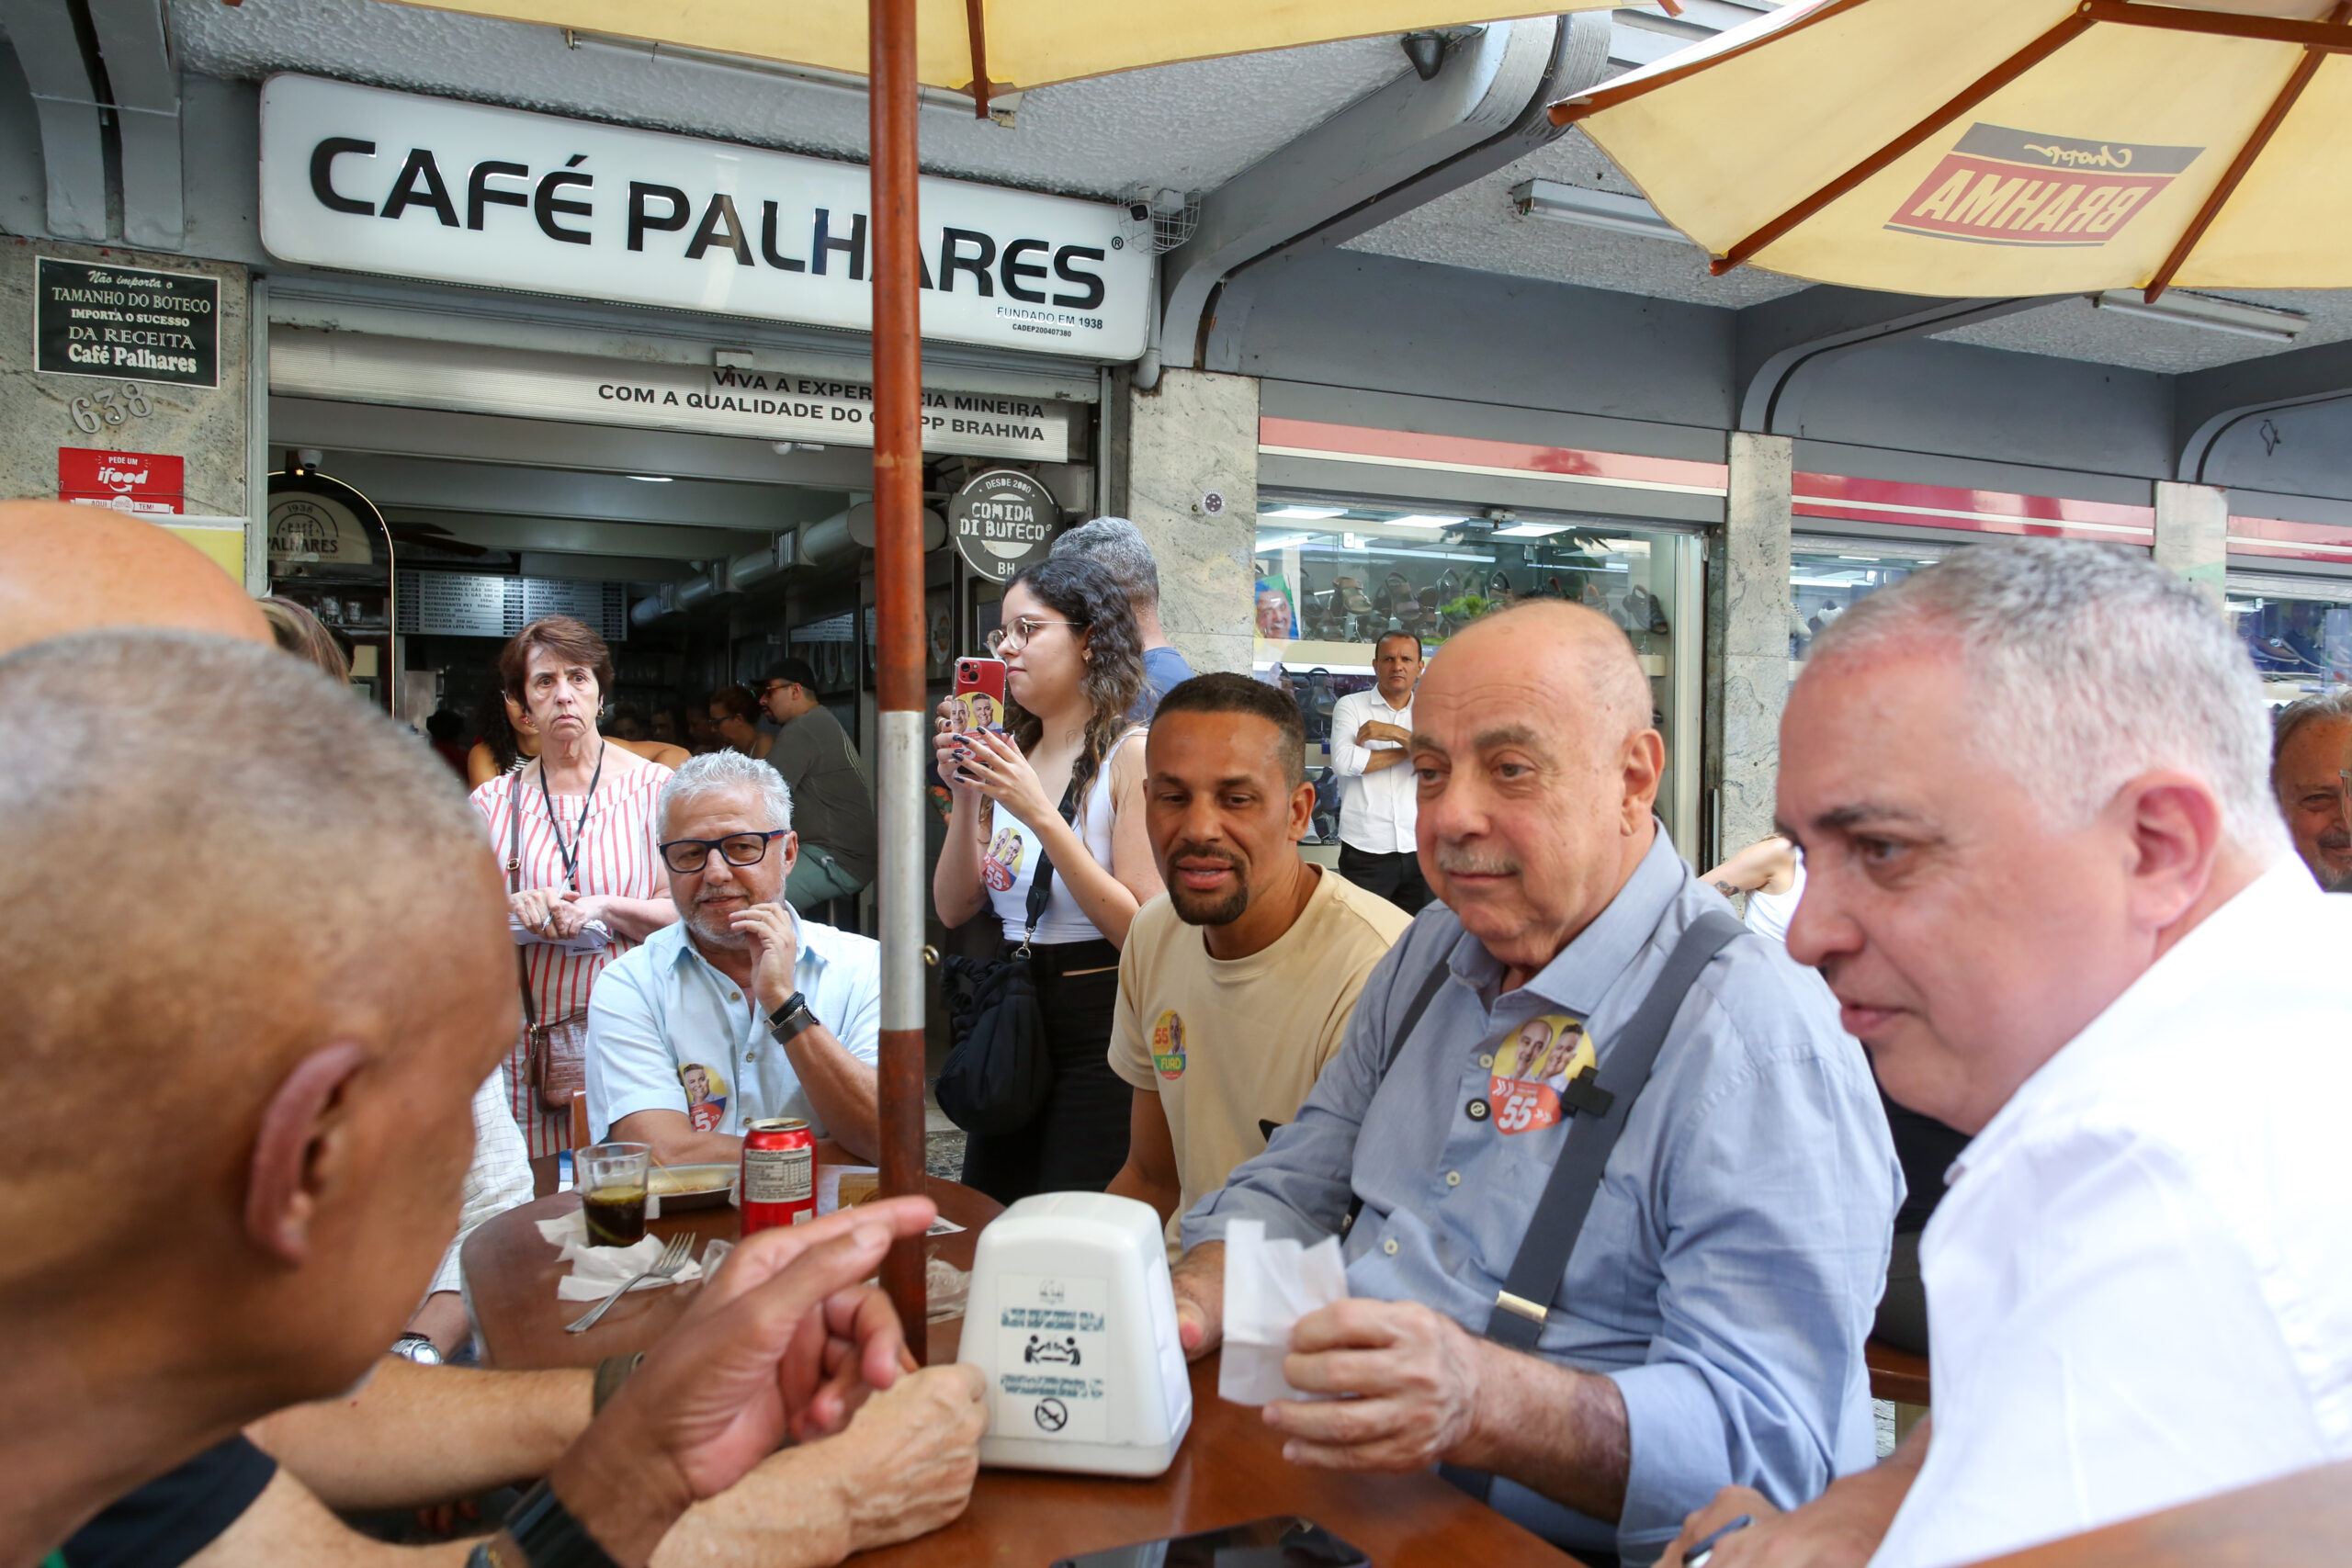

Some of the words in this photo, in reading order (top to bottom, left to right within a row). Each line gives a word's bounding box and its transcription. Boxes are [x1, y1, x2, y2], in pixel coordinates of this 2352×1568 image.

[310, 136, 594, 246] CAFÉ
[628, 180, 1105, 310] PALHRES
[88, 270, 112, 284] Não
[116, 275, 162, 288] importa
[166, 281, 174, 289] o
[51, 287, 124, 306] TAMANHO
[128, 292, 150, 308] DO
[153, 295, 211, 314] BOTECO
[71, 308, 123, 321] IMPORTA
[125, 312, 134, 322] O
[136, 314, 190, 328] SUCESSO
[997, 306, 1055, 322] FUNDADO
[1058, 314, 1075, 325] EM
[1079, 317, 1103, 330] 1938
[68, 326, 98, 342] DA
[104, 328, 196, 351] RECEITA
[1012, 323, 1072, 337] CADEP200407380
[68, 344, 110, 365] Café
[114, 346, 198, 374] Palhares
[713, 370, 769, 391] VIVA
[775, 378, 791, 392] A
[955, 396, 1045, 419] MINEIRA
[71, 380, 154, 434] 638
[598, 384, 655, 404] COM
[663, 390, 679, 406] A
[686, 392, 824, 420] QUALIDADE
[831, 406, 863, 423] DO
[952, 419, 1045, 441] BRAHMA
[108, 456, 126, 464] PEDE
[127, 457, 138, 466] UM
[985, 478, 1012, 491] DESDE
[1012, 479, 1032, 493] 2000
[139, 502, 154, 511] TEM!
[971, 502, 1035, 523] COMIDA
[959, 518, 980, 536] DI
[997, 561, 1015, 576] BH
[1155, 1027, 1169, 1044] 55
[1498, 1094, 1538, 1130] 55
